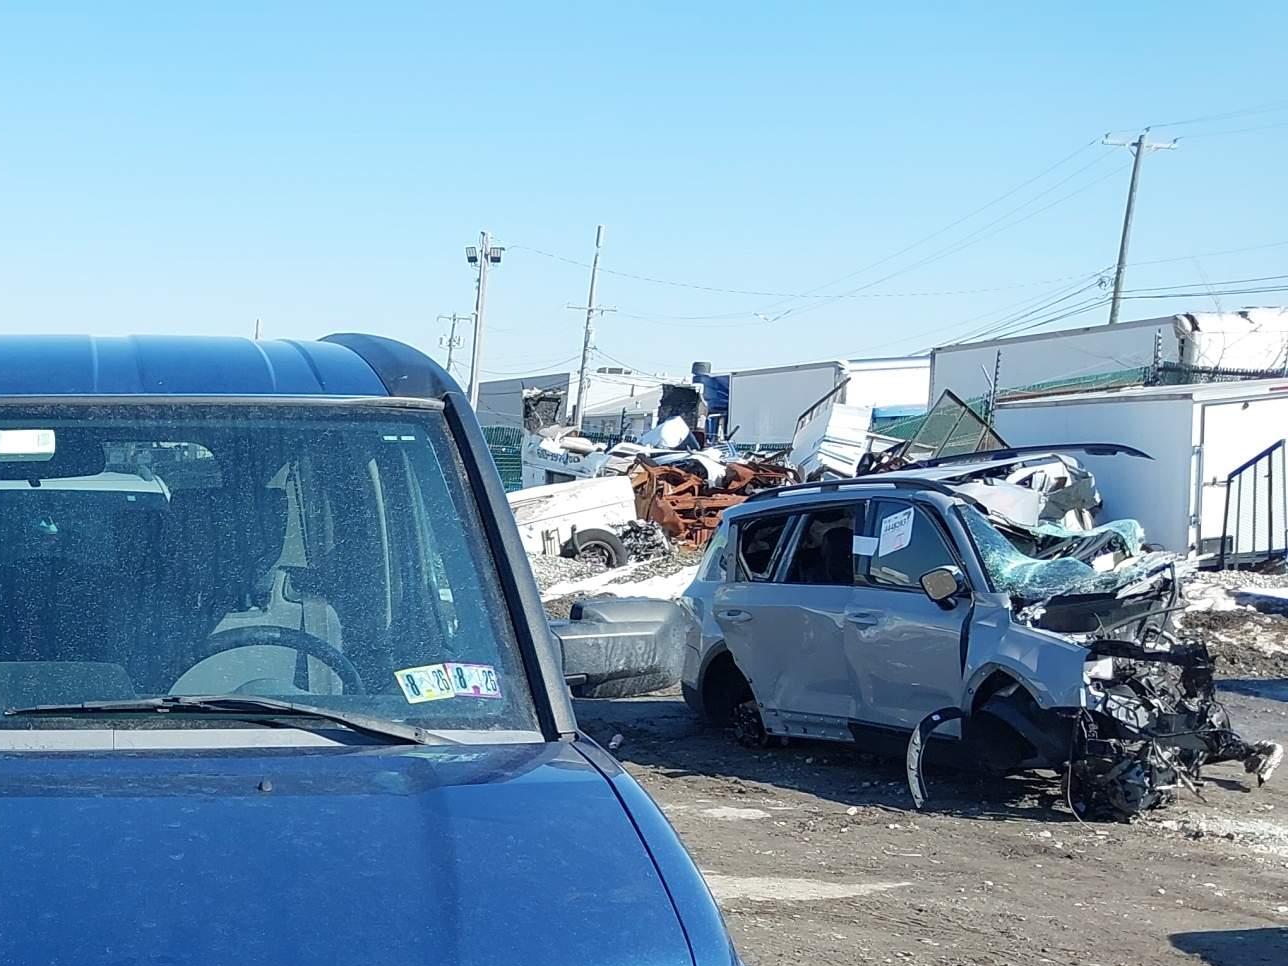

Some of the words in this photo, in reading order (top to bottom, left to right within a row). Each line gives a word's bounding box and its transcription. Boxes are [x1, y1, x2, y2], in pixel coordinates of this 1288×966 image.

[406, 674, 420, 696] 8
[432, 669, 450, 691] 26
[456, 667, 467, 689] 8
